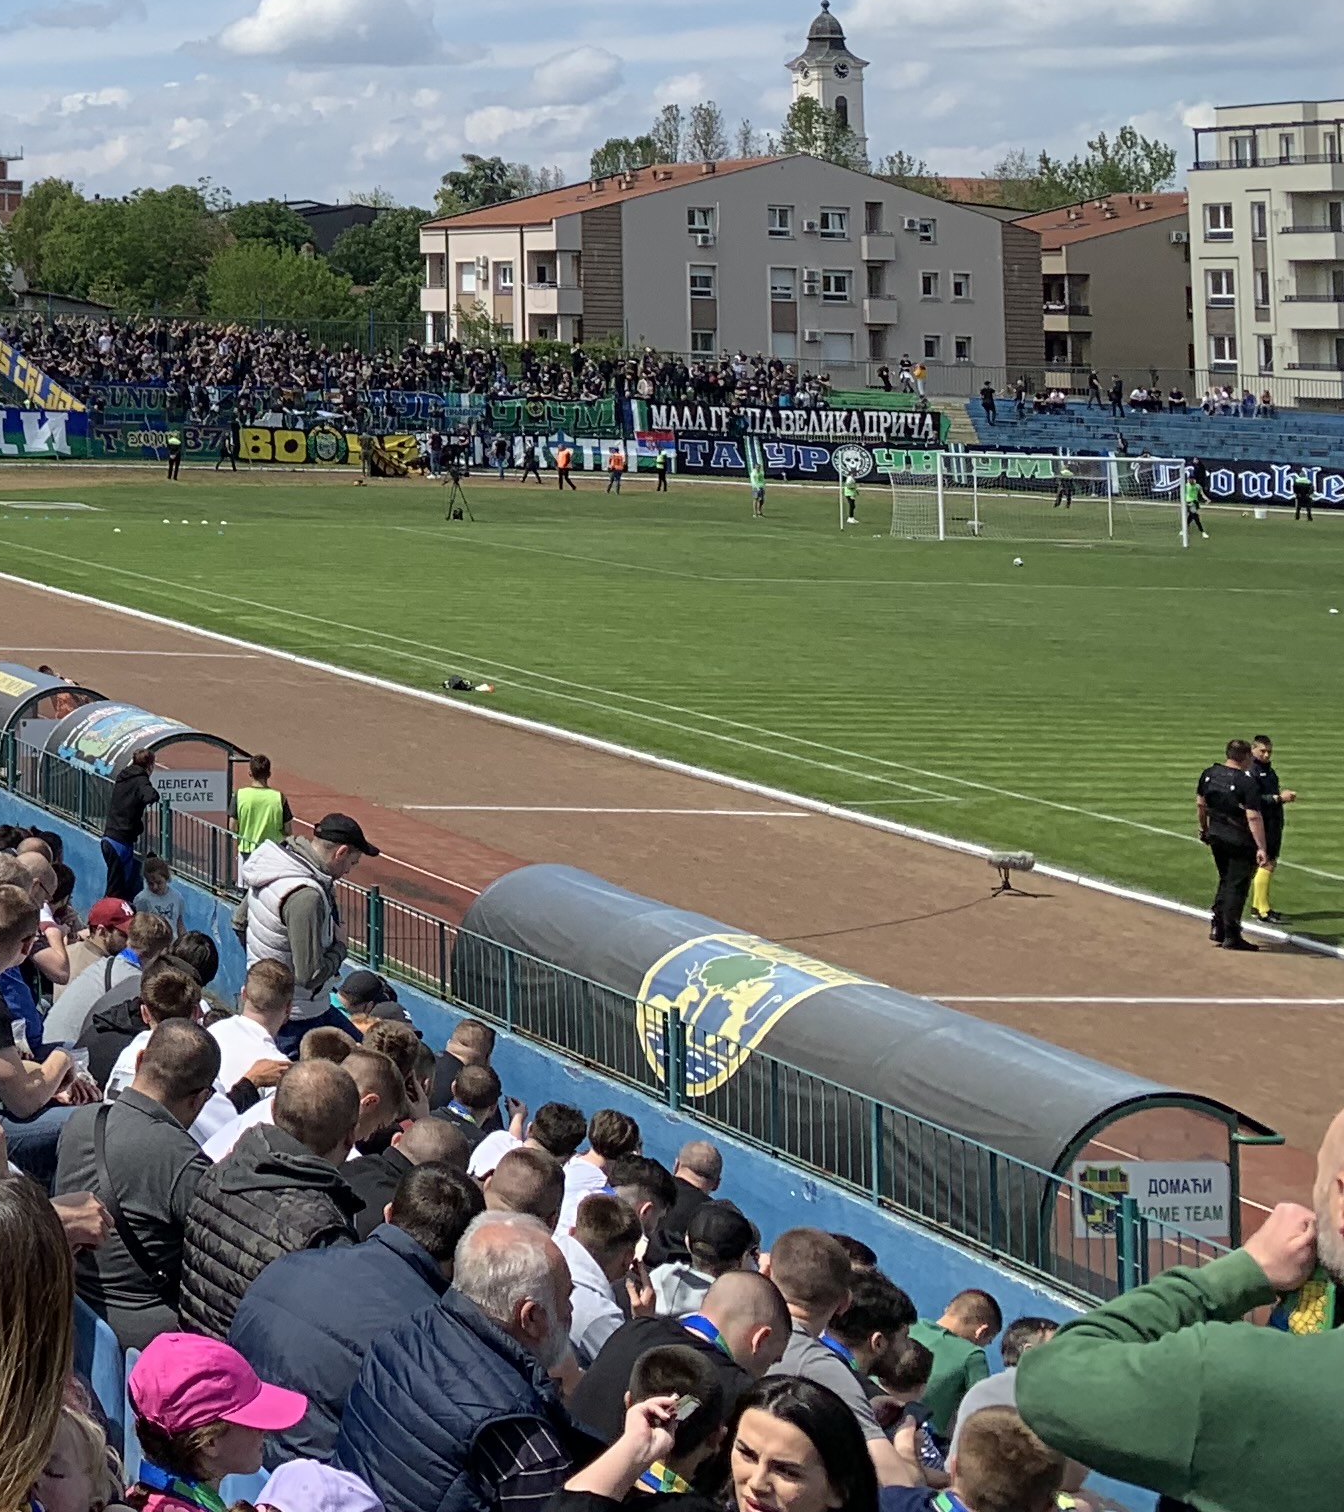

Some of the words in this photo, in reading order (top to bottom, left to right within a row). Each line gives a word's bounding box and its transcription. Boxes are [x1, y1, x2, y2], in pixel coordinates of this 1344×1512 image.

[651, 404, 707, 430] МАЛА
[709, 406, 781, 438] ГРПА,
[157, 779, 208, 790] ДЕЛЕГАТ
[160, 792, 214, 802] ELEGATE
[1148, 1177, 1212, 1197] ДОМАЋИ
[1184, 1205, 1224, 1222] TEAM
